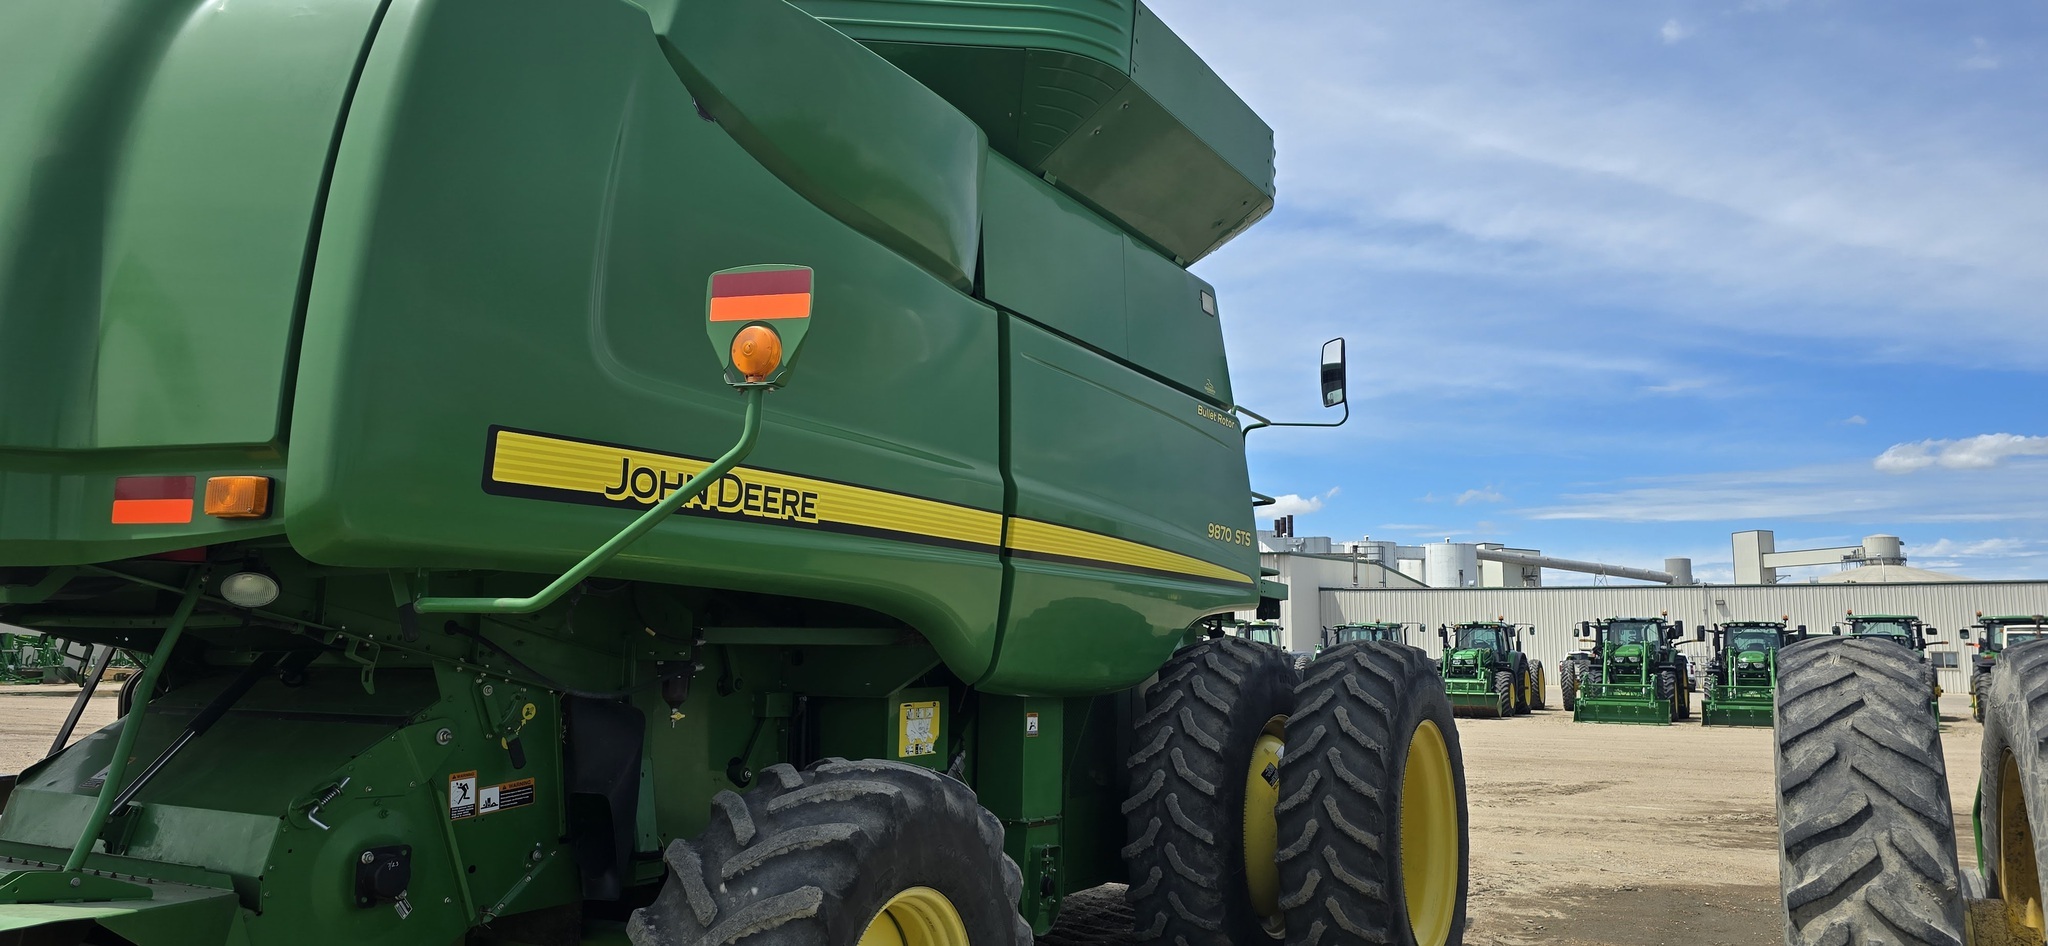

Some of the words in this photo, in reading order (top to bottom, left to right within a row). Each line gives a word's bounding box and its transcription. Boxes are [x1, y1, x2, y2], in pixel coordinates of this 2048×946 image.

[1198, 405, 1217, 422] Bullet
[1217, 413, 1235, 429] Rotor
[718, 473, 818, 519] DEERE
[1208, 522, 1232, 543] 9870
[1235, 529, 1251, 547] STS
[508, 779, 531, 788] WARNING
